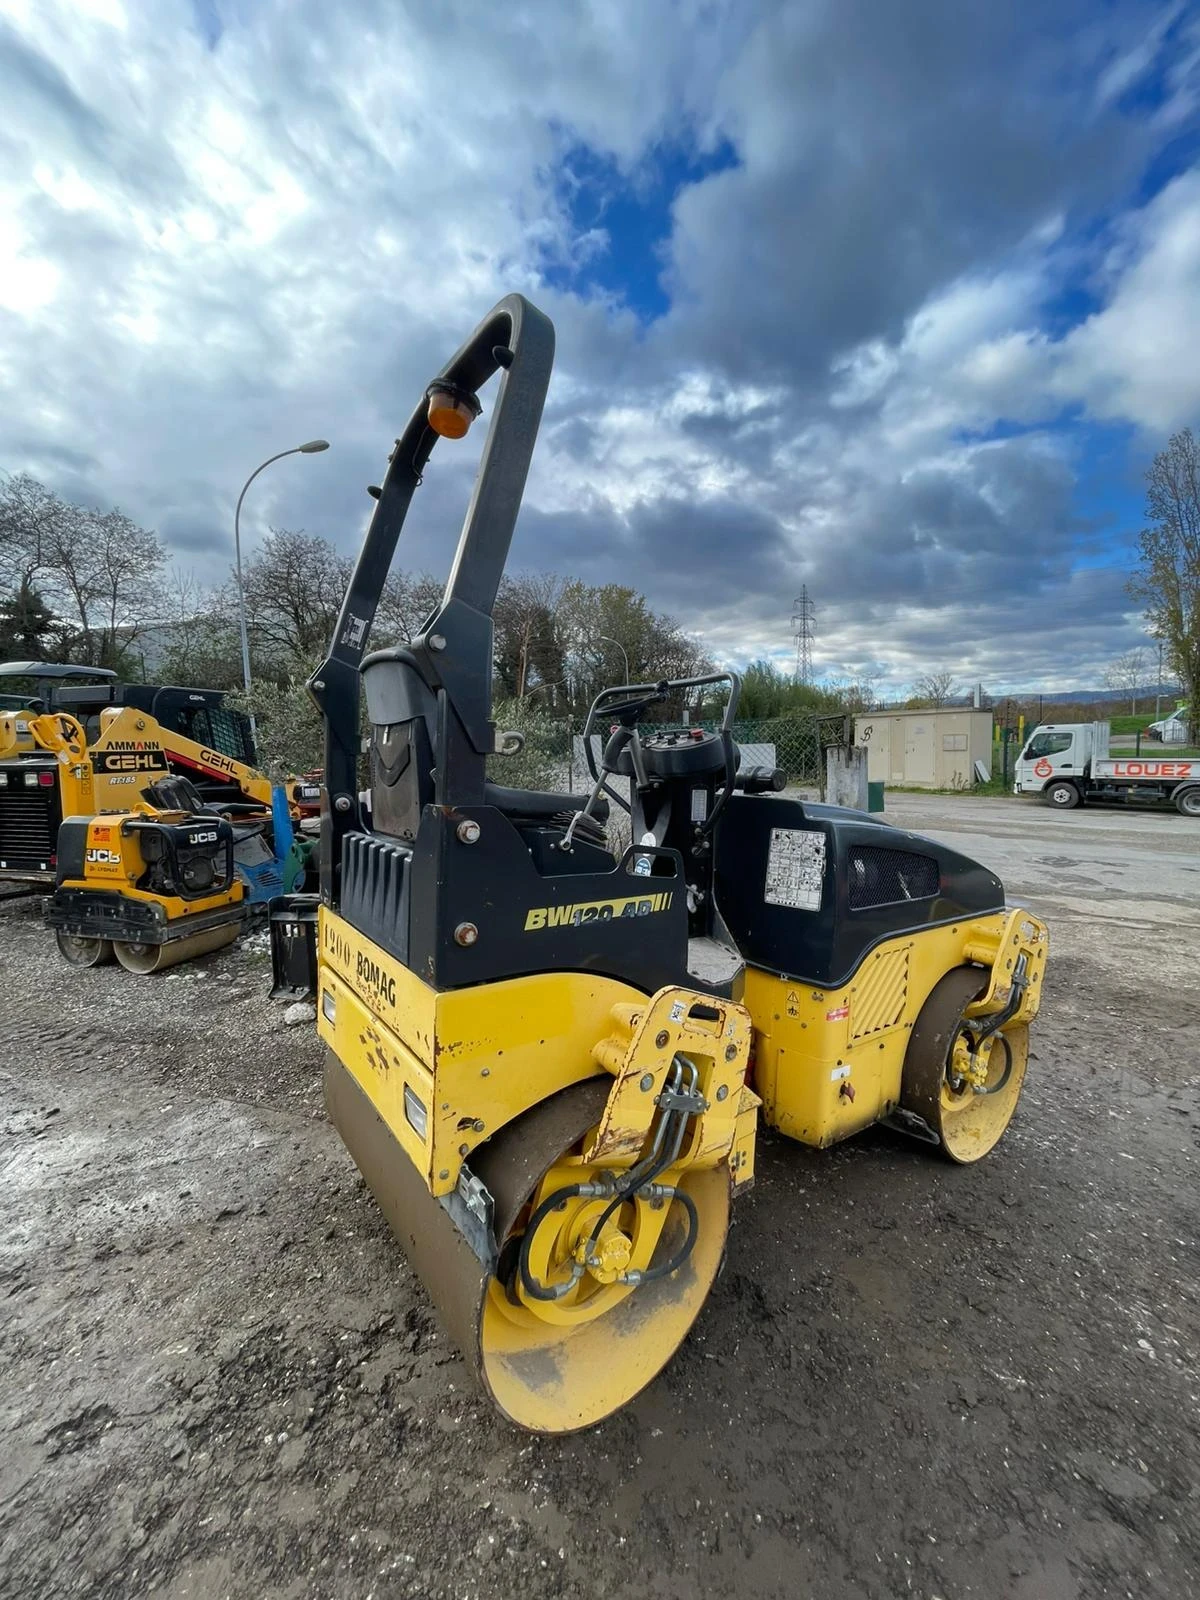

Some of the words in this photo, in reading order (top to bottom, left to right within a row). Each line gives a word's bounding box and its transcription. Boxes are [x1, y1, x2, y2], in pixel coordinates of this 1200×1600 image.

[106, 741, 160, 751] AMMANN
[105, 755, 162, 769] GEHL
[200, 750, 238, 775] GEHL
[1114, 764, 1192, 776] LOUEZ
[110, 776, 136, 785] RT185
[189, 832, 218, 844] JCB
[325, 923, 350, 968] 1200
[357, 950, 396, 1008] BOMAG
